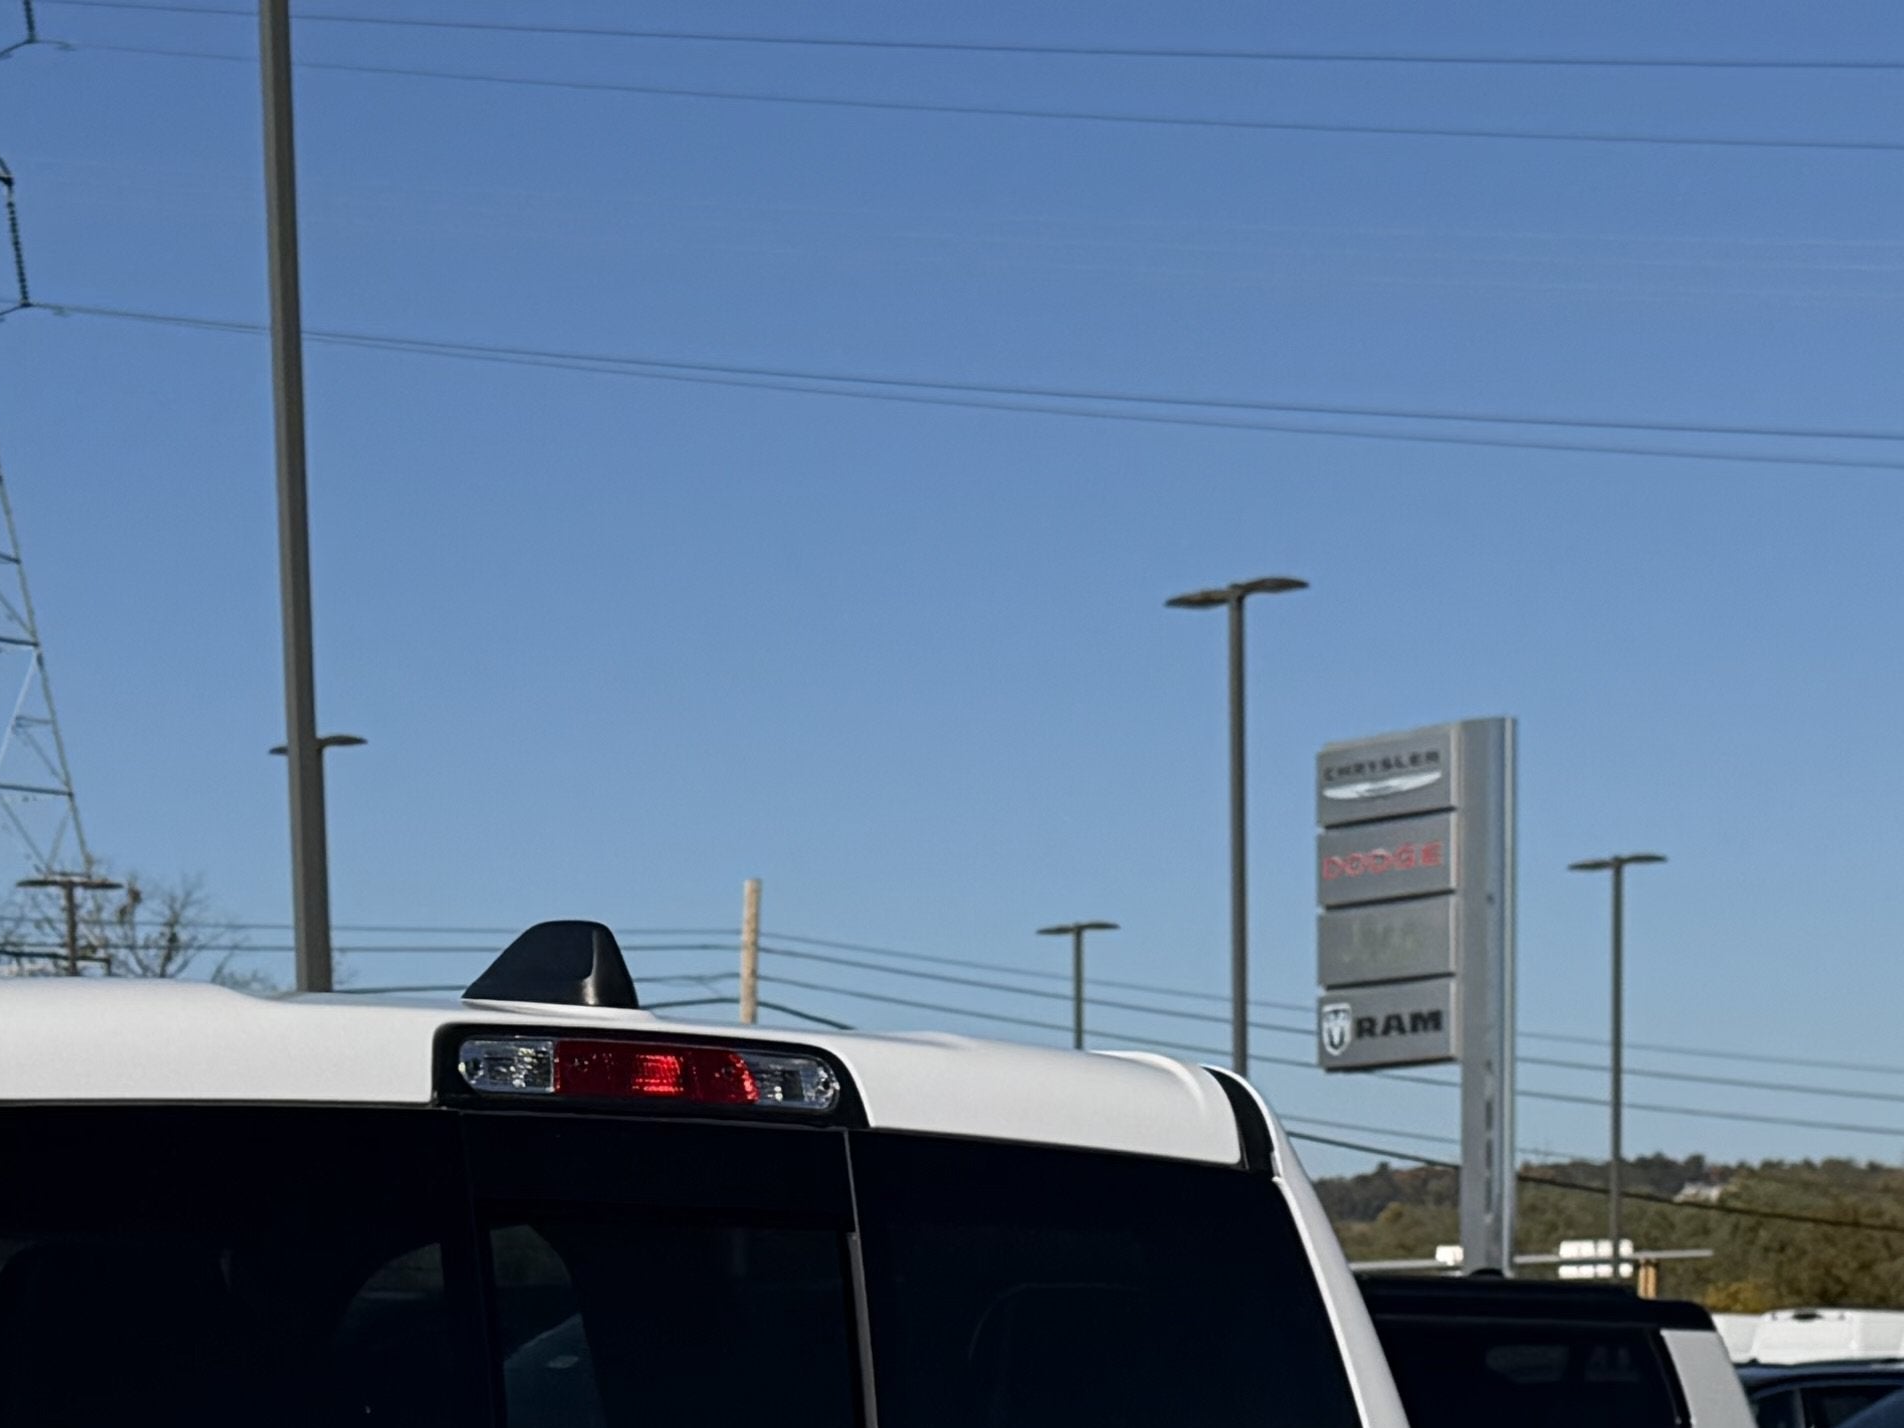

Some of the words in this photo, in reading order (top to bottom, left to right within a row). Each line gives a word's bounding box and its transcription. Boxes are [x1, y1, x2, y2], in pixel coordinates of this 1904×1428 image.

[1322, 751, 1439, 781] CHRYSLER
[1322, 841, 1442, 880] DODGE
[1356, 1009, 1443, 1039] RAM
